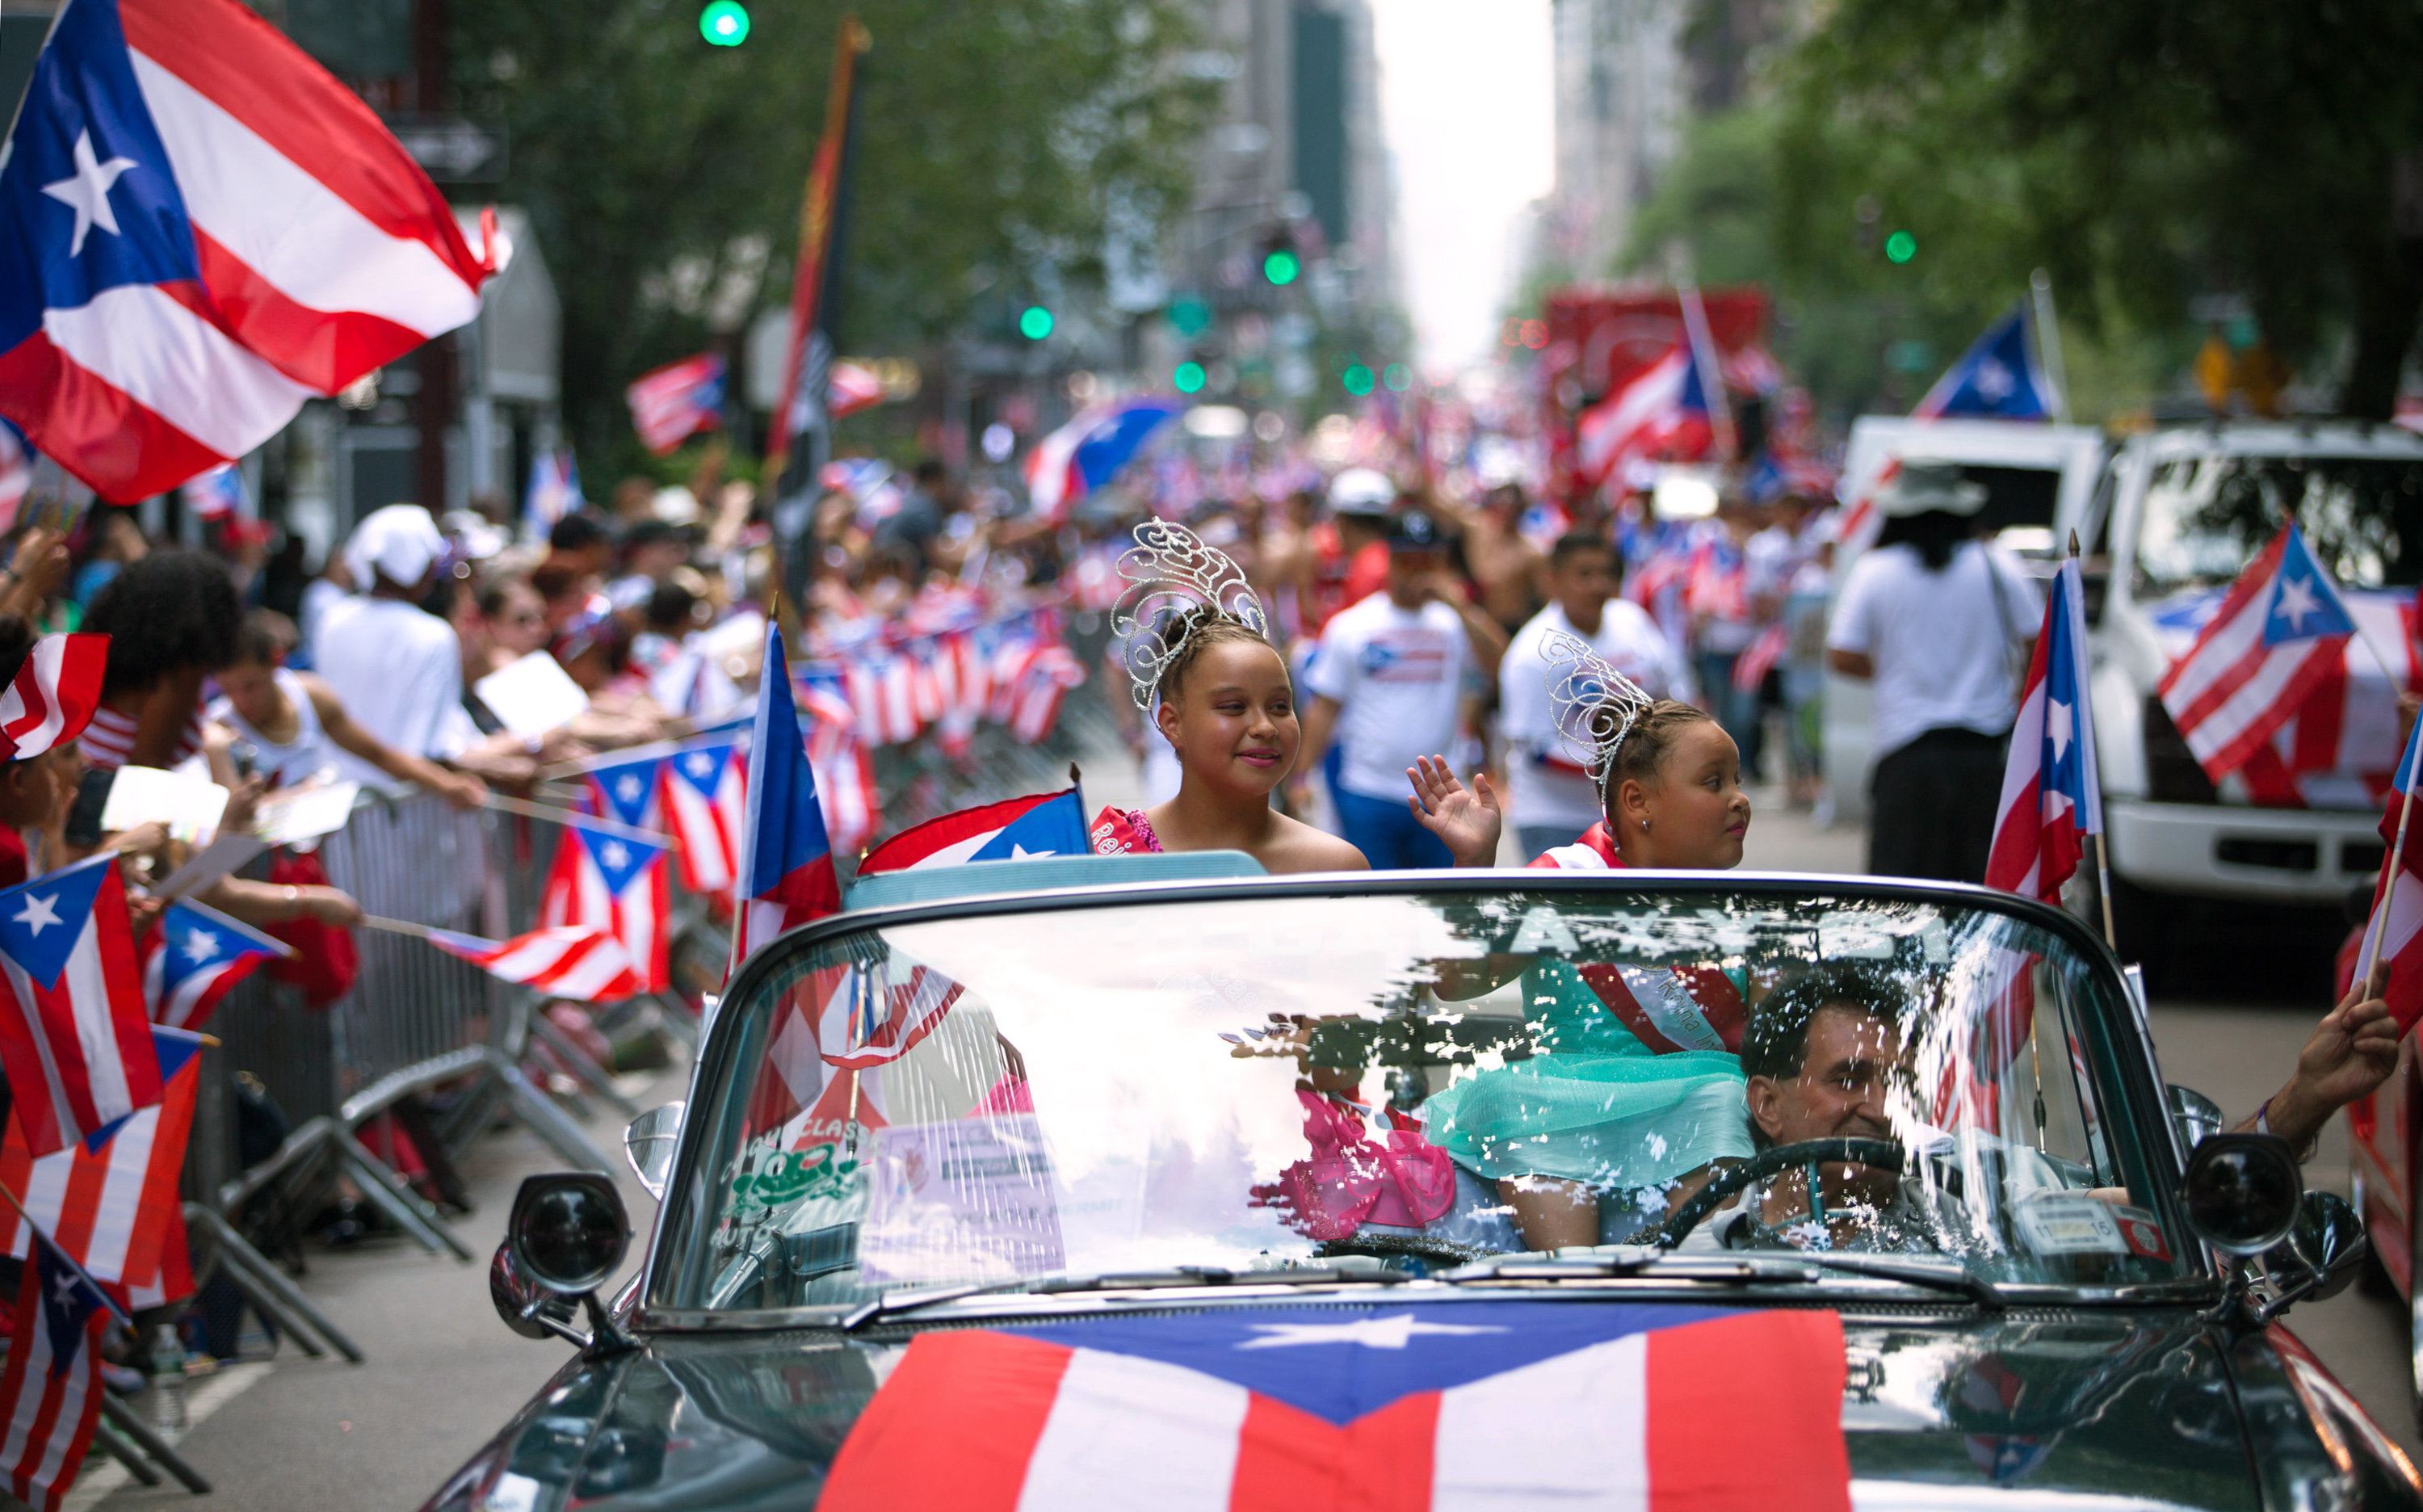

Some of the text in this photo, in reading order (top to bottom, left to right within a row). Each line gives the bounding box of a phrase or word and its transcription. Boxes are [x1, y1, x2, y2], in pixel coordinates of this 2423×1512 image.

[1657, 976, 1700, 1032] Reina
[709, 1225, 773, 1246] AUTO
[2089, 1220, 2112, 1237] 15
